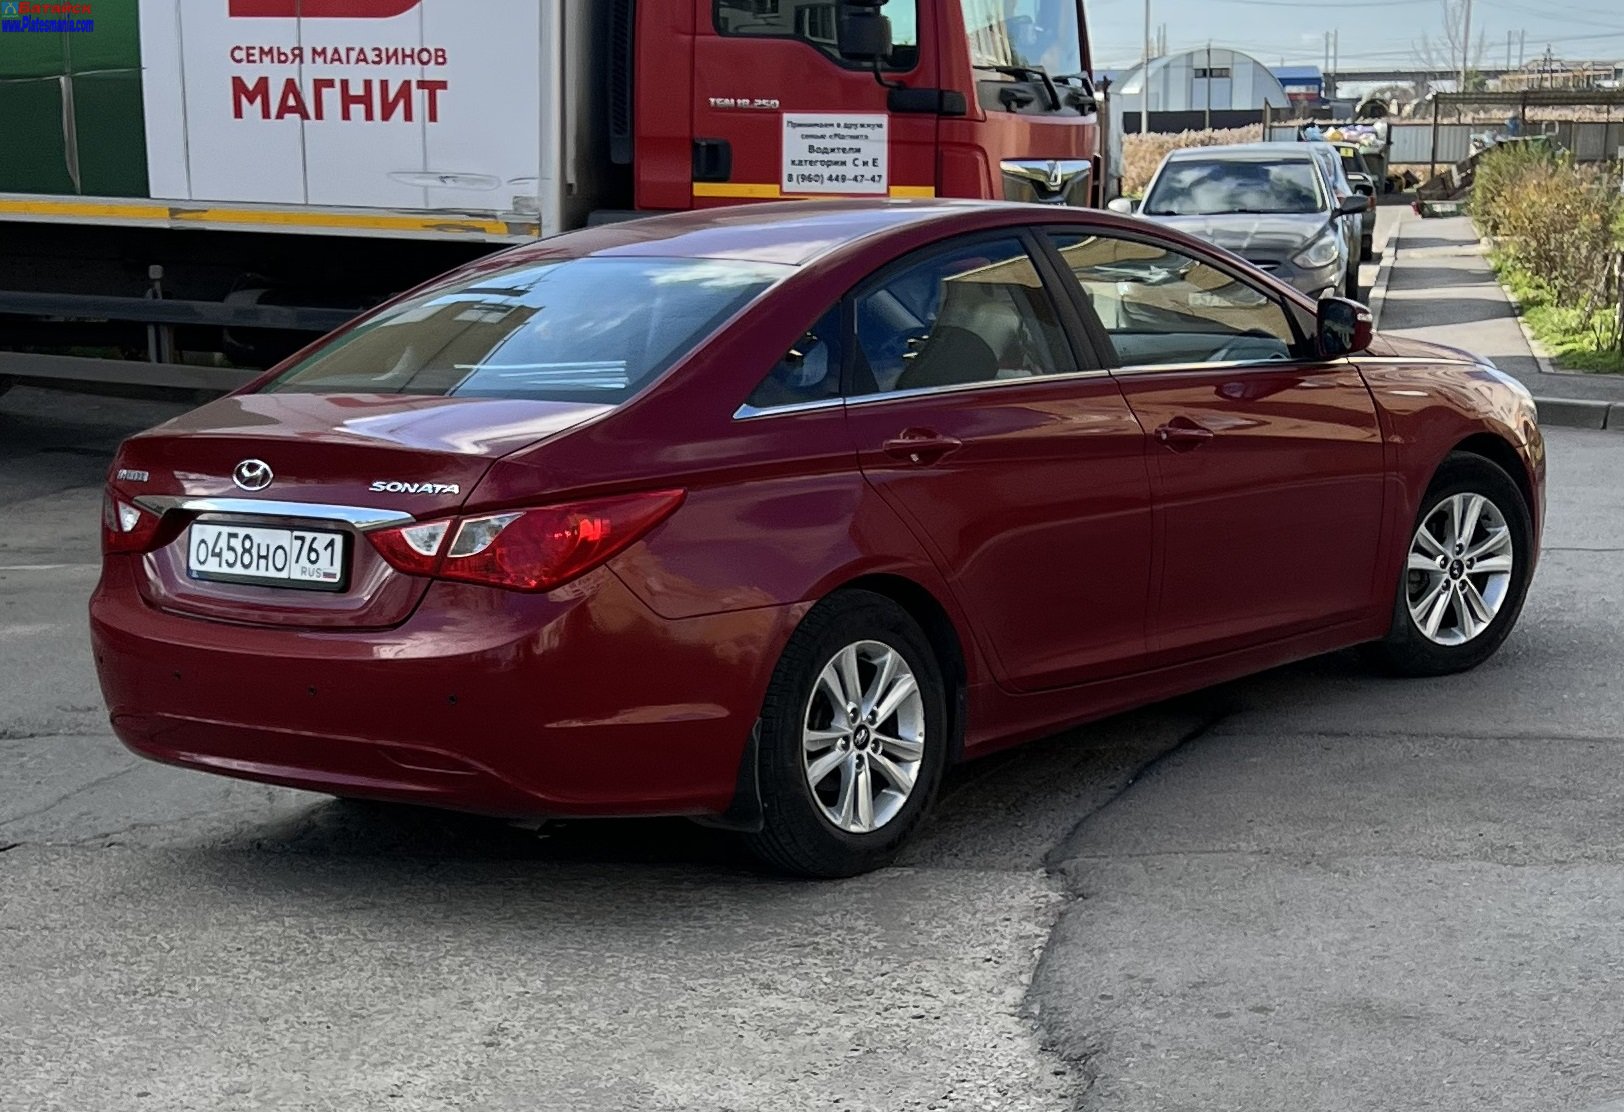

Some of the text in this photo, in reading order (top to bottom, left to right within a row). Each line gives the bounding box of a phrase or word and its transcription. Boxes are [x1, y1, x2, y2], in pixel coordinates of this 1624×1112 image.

[230, 45, 448, 66] СЕМЬЯ МАГАЗИНОВ
[231, 76, 448, 123] МАГНИТ
[808, 144, 862, 155] Водители
[790, 159, 848, 168] категории
[787, 173, 794, 183] 8
[368, 481, 460, 495] SONATA
[300, 565, 323, 578] RUS
